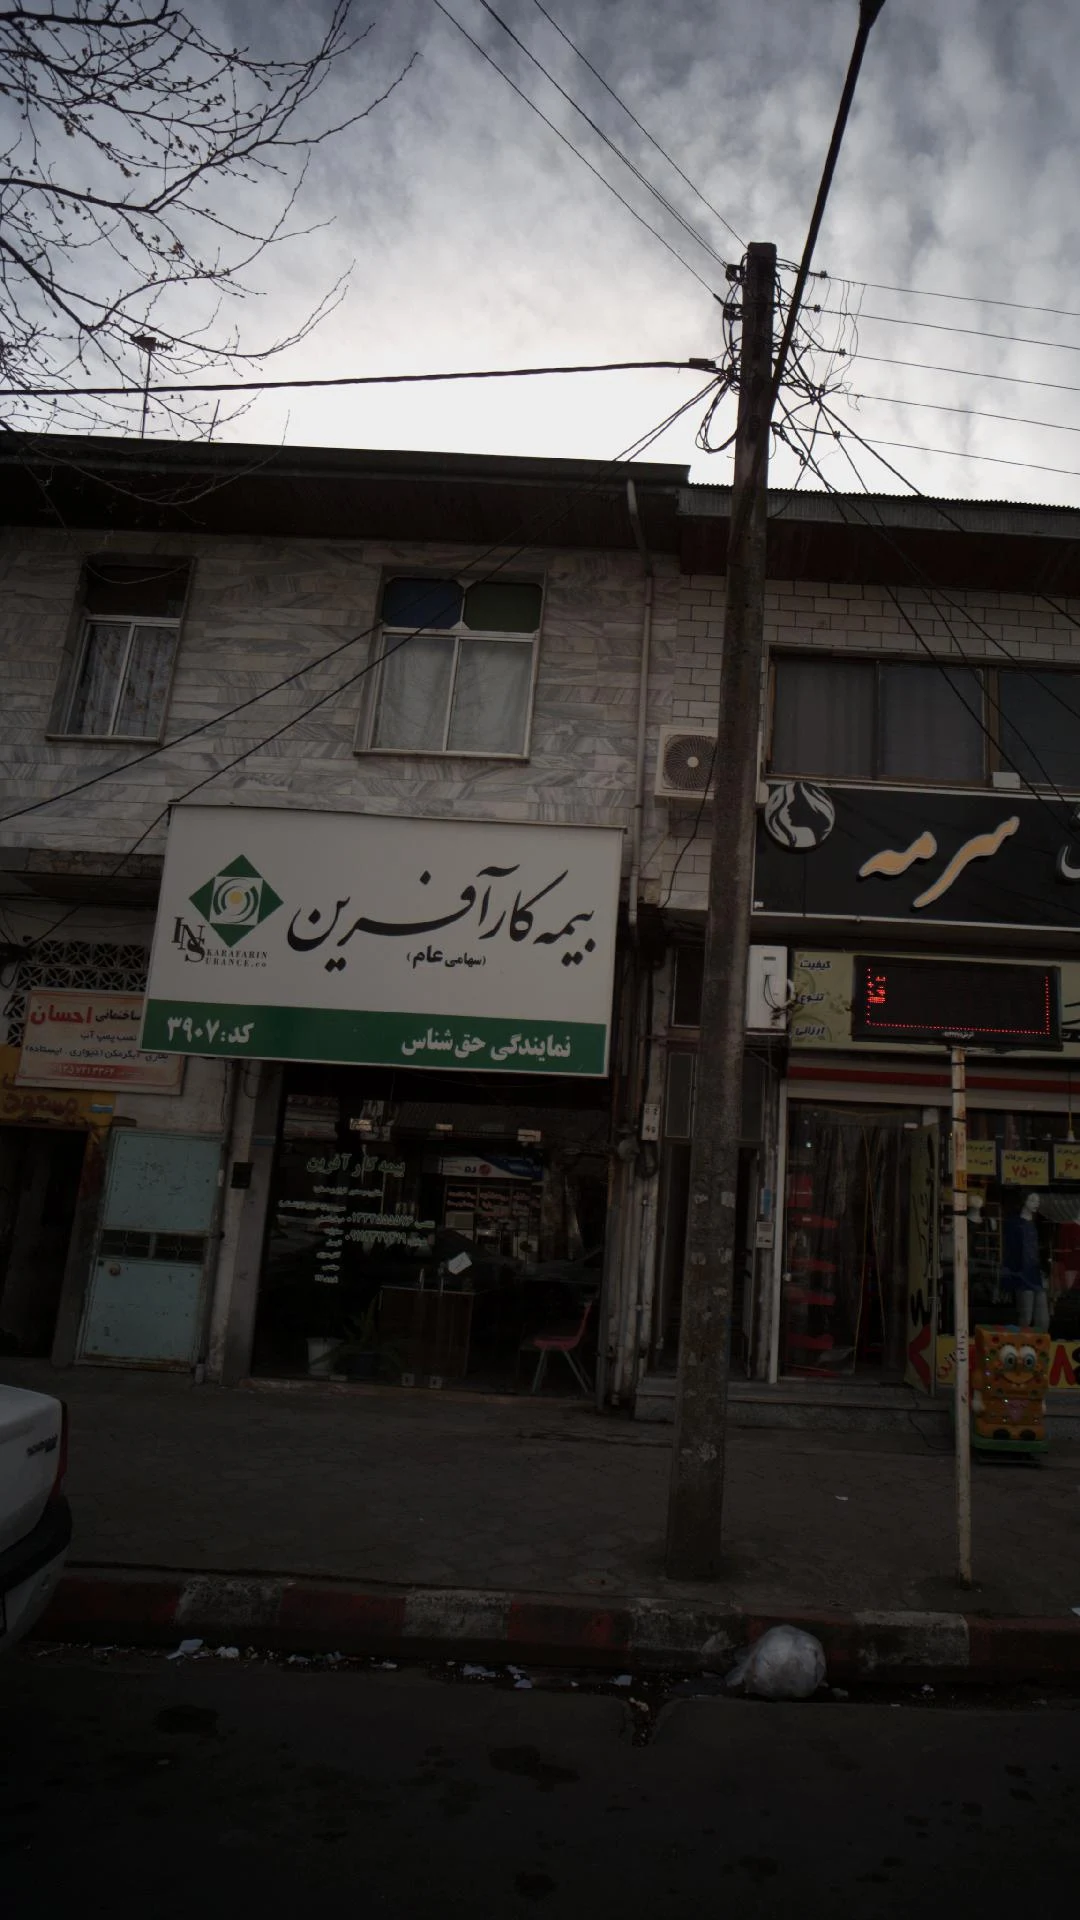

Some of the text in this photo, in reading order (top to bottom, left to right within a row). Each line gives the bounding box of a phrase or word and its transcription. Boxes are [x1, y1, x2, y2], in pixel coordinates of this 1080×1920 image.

[287, 863, 596, 973] بیمه کارآفرین
[799, 959, 832, 970] کیفیت
[800, 993, 825, 1004] تنوع
[30, 1004, 94, 1025] احسان
[489, 1033, 571, 1062] نمایندگی
